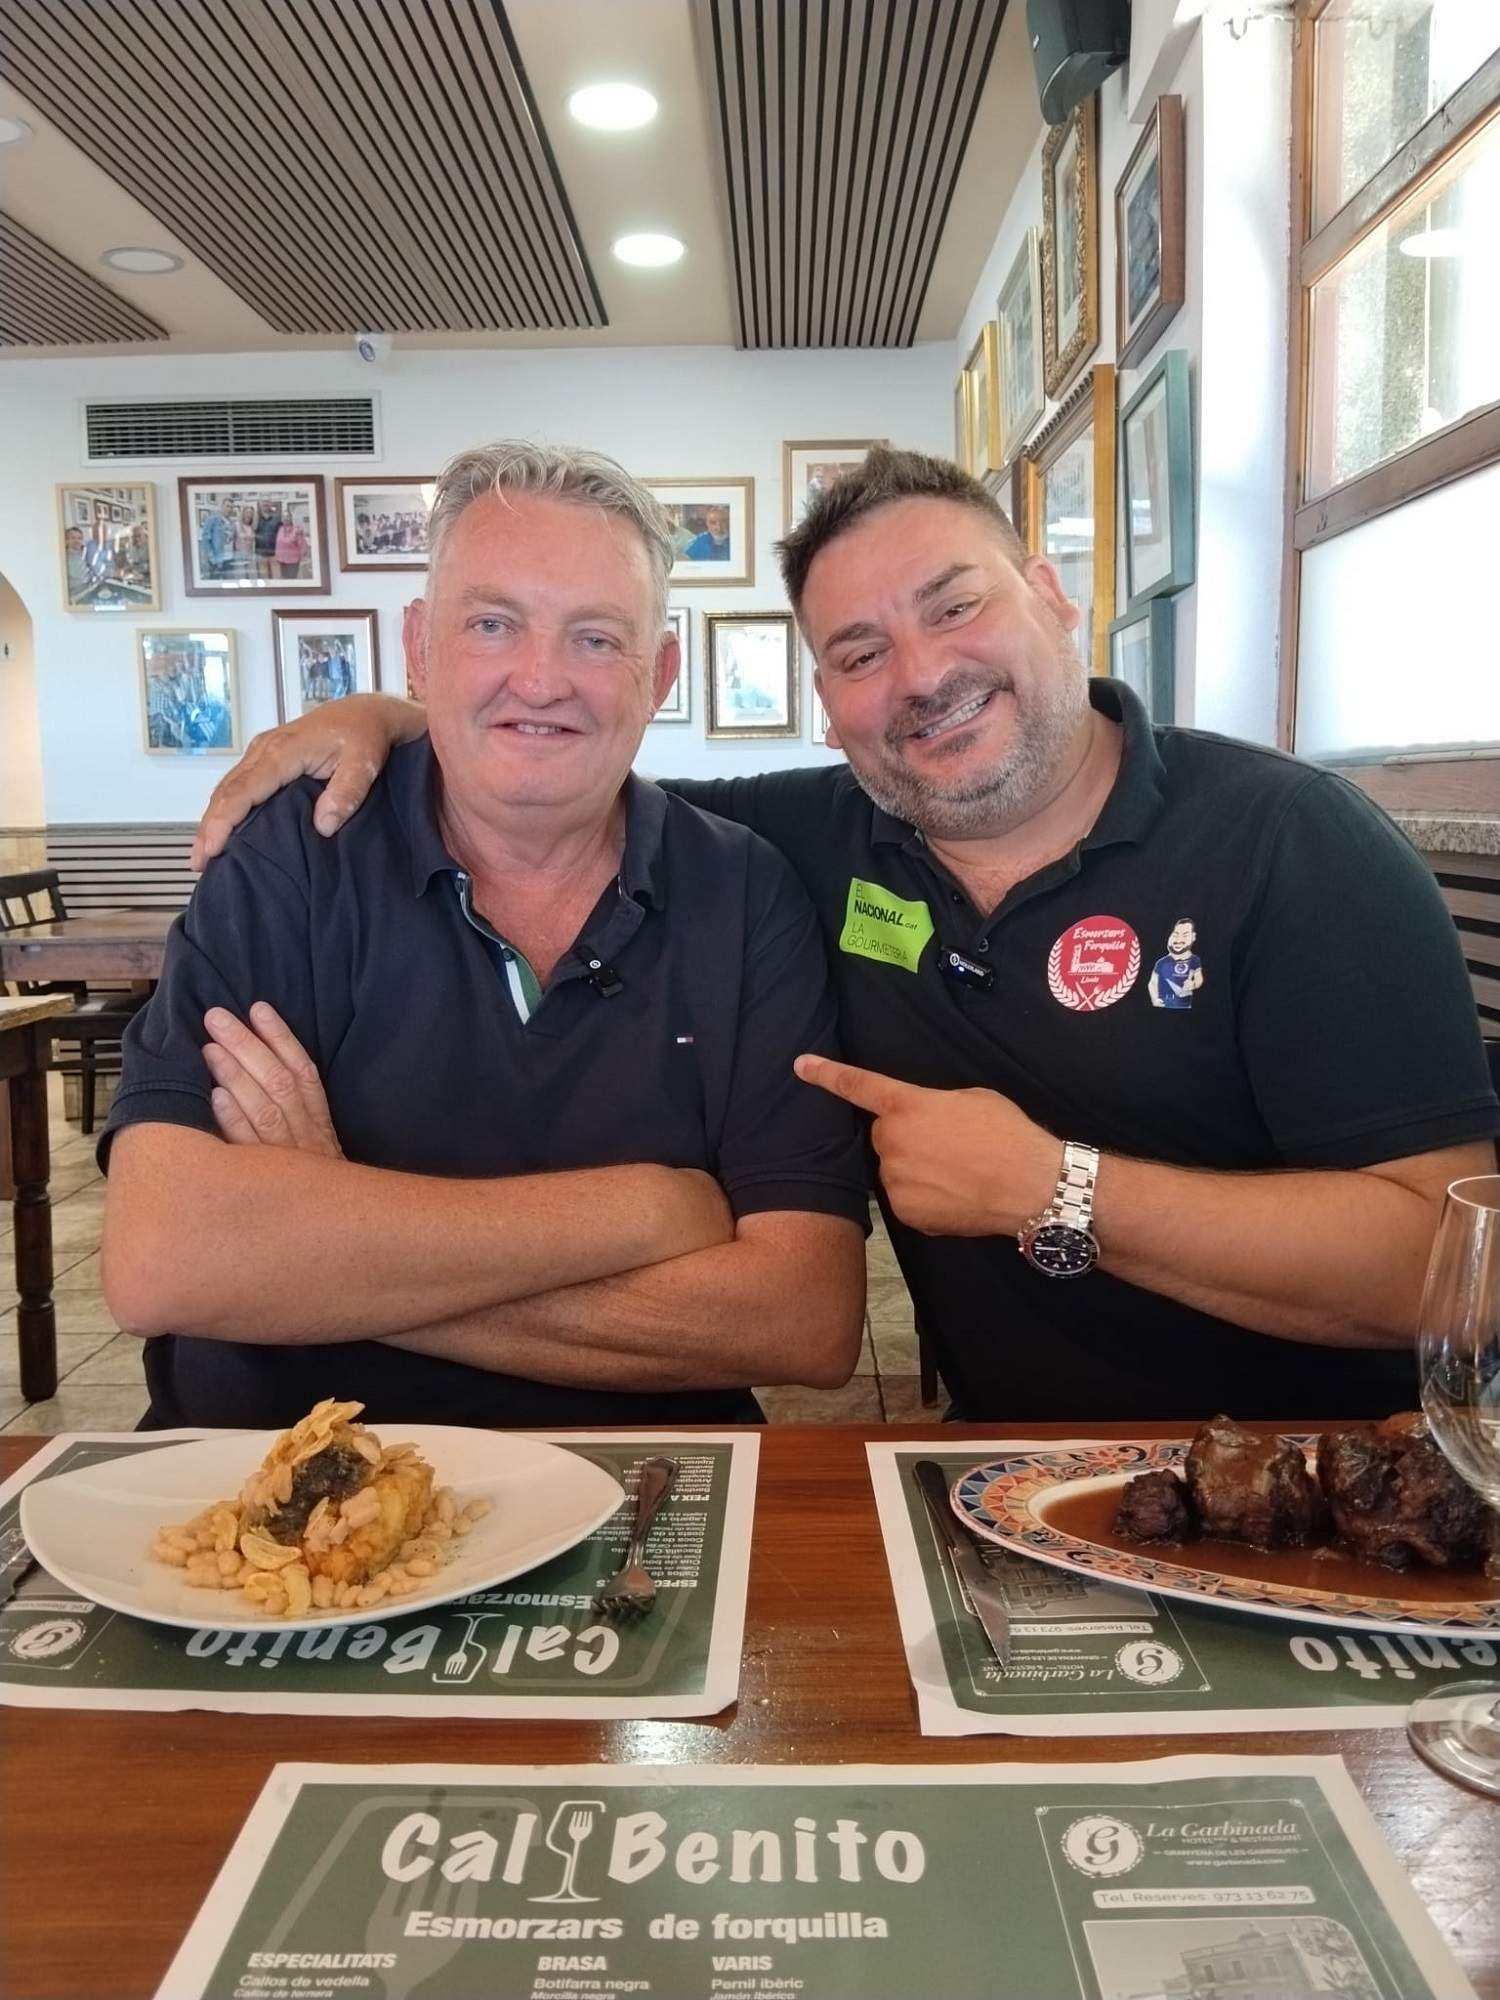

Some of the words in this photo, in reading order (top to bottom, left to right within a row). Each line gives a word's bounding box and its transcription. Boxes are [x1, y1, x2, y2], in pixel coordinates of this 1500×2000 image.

[855, 883, 866, 900] EL
[852, 921, 864, 935] LA
[443, 1594, 593, 1609] Esmorzar
[186, 1625, 442, 1674] Benito
[492, 1624, 619, 1675] Cal
[1289, 1634, 1497, 1680] enito
[1089, 1669, 1114, 1681] La
[1146, 1823, 1175, 1838] La
[1181, 1819, 1297, 1838] Garbinada
[381, 1812, 538, 1885] Cal
[607, 1811, 926, 1884] Benito
[404, 1911, 624, 1940] Esmorzars
[649, 1913, 701, 1940] de
[711, 1912, 889, 1945] forquilla
[247, 1953, 398, 1969] ESPECIALITATS
[537, 1955, 609, 1972] BRASA
[711, 1955, 773, 1972] VARIS
[239, 1975, 288, 1987] Callos
[290, 1976, 312, 1987] de
[315, 1975, 370, 1987] vedella
[533, 1978, 601, 1990] Botifarra
[604, 1980, 650, 1992] negra
[711, 1978, 756, 1990] Pernil
